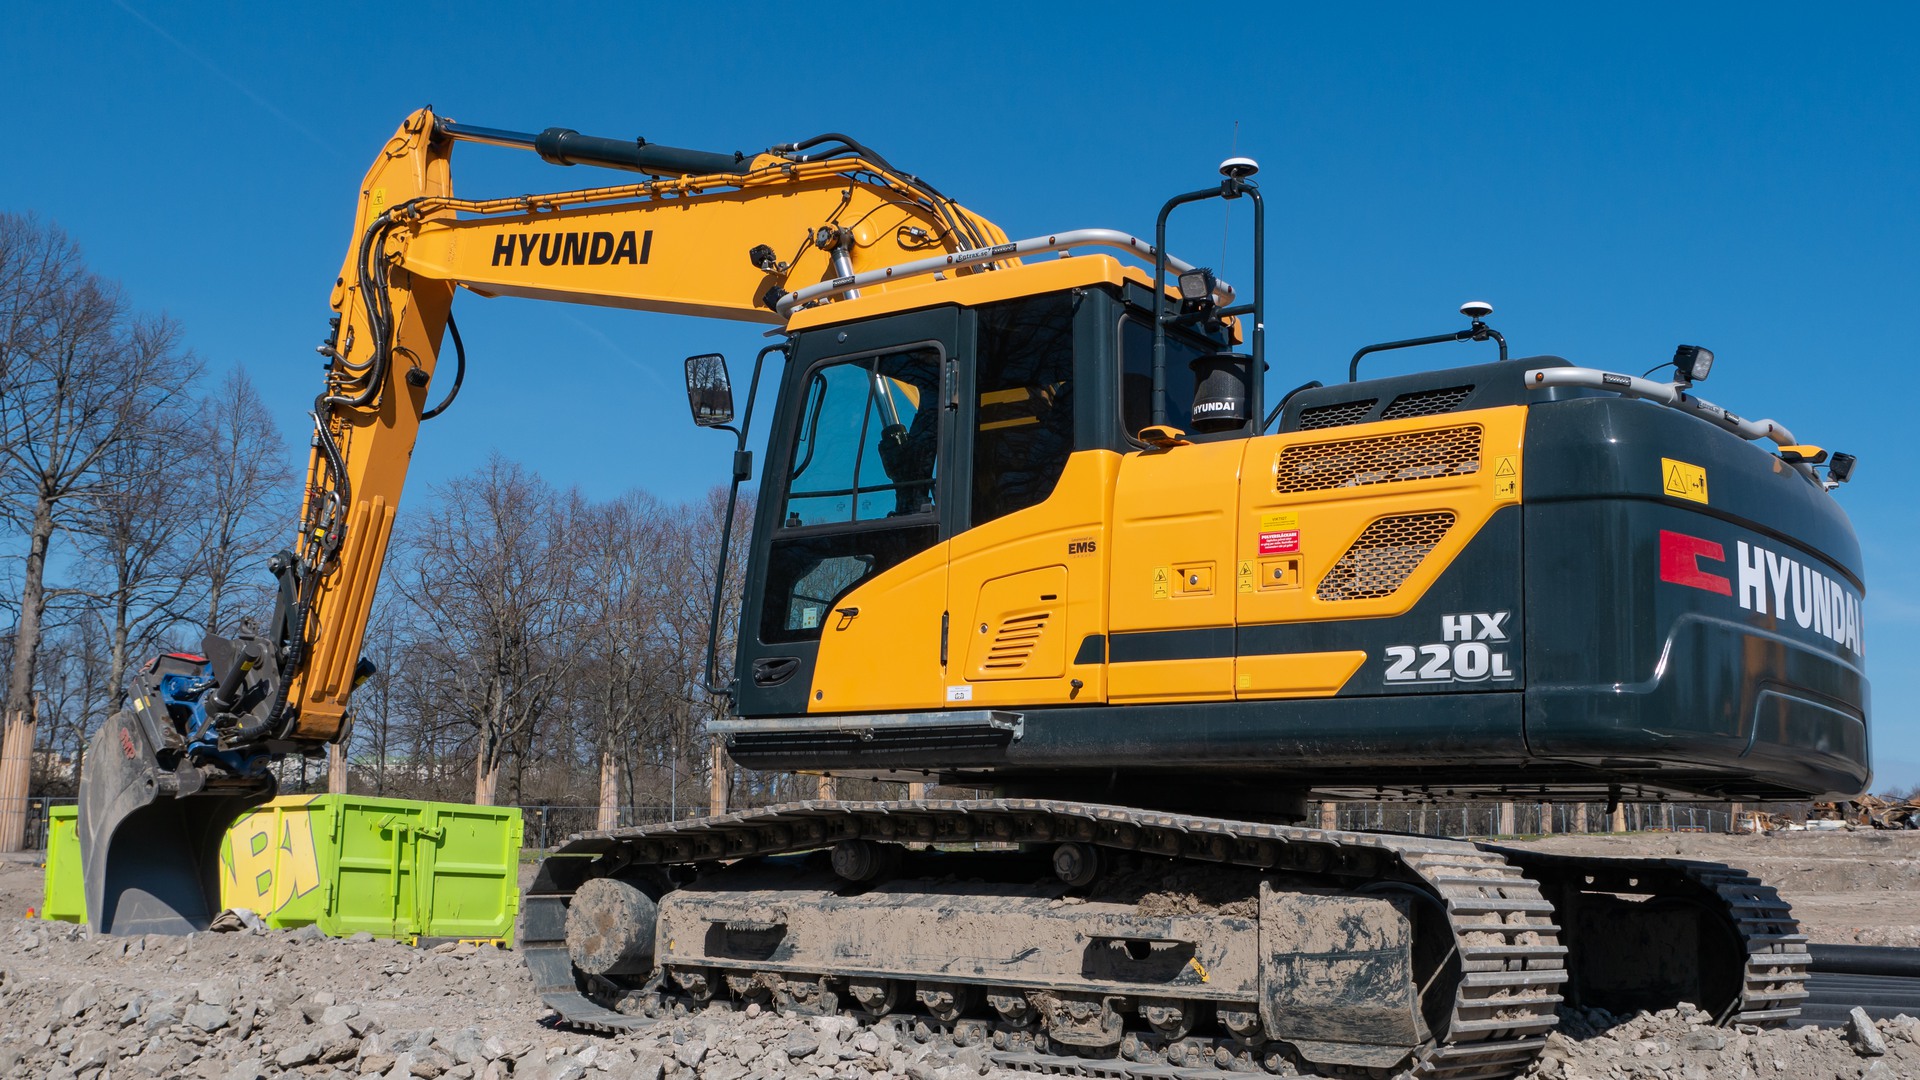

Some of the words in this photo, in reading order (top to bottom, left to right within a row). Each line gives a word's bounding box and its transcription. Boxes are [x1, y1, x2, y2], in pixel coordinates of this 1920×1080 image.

[491, 230, 653, 266] HYUNDAI
[1193, 401, 1235, 415] HYUNDAI
[1068, 541, 1096, 554] EMS
[1737, 540, 1861, 657] HYUNDAI
[1442, 612, 1509, 642] HX
[1384, 642, 1513, 682] 220L
